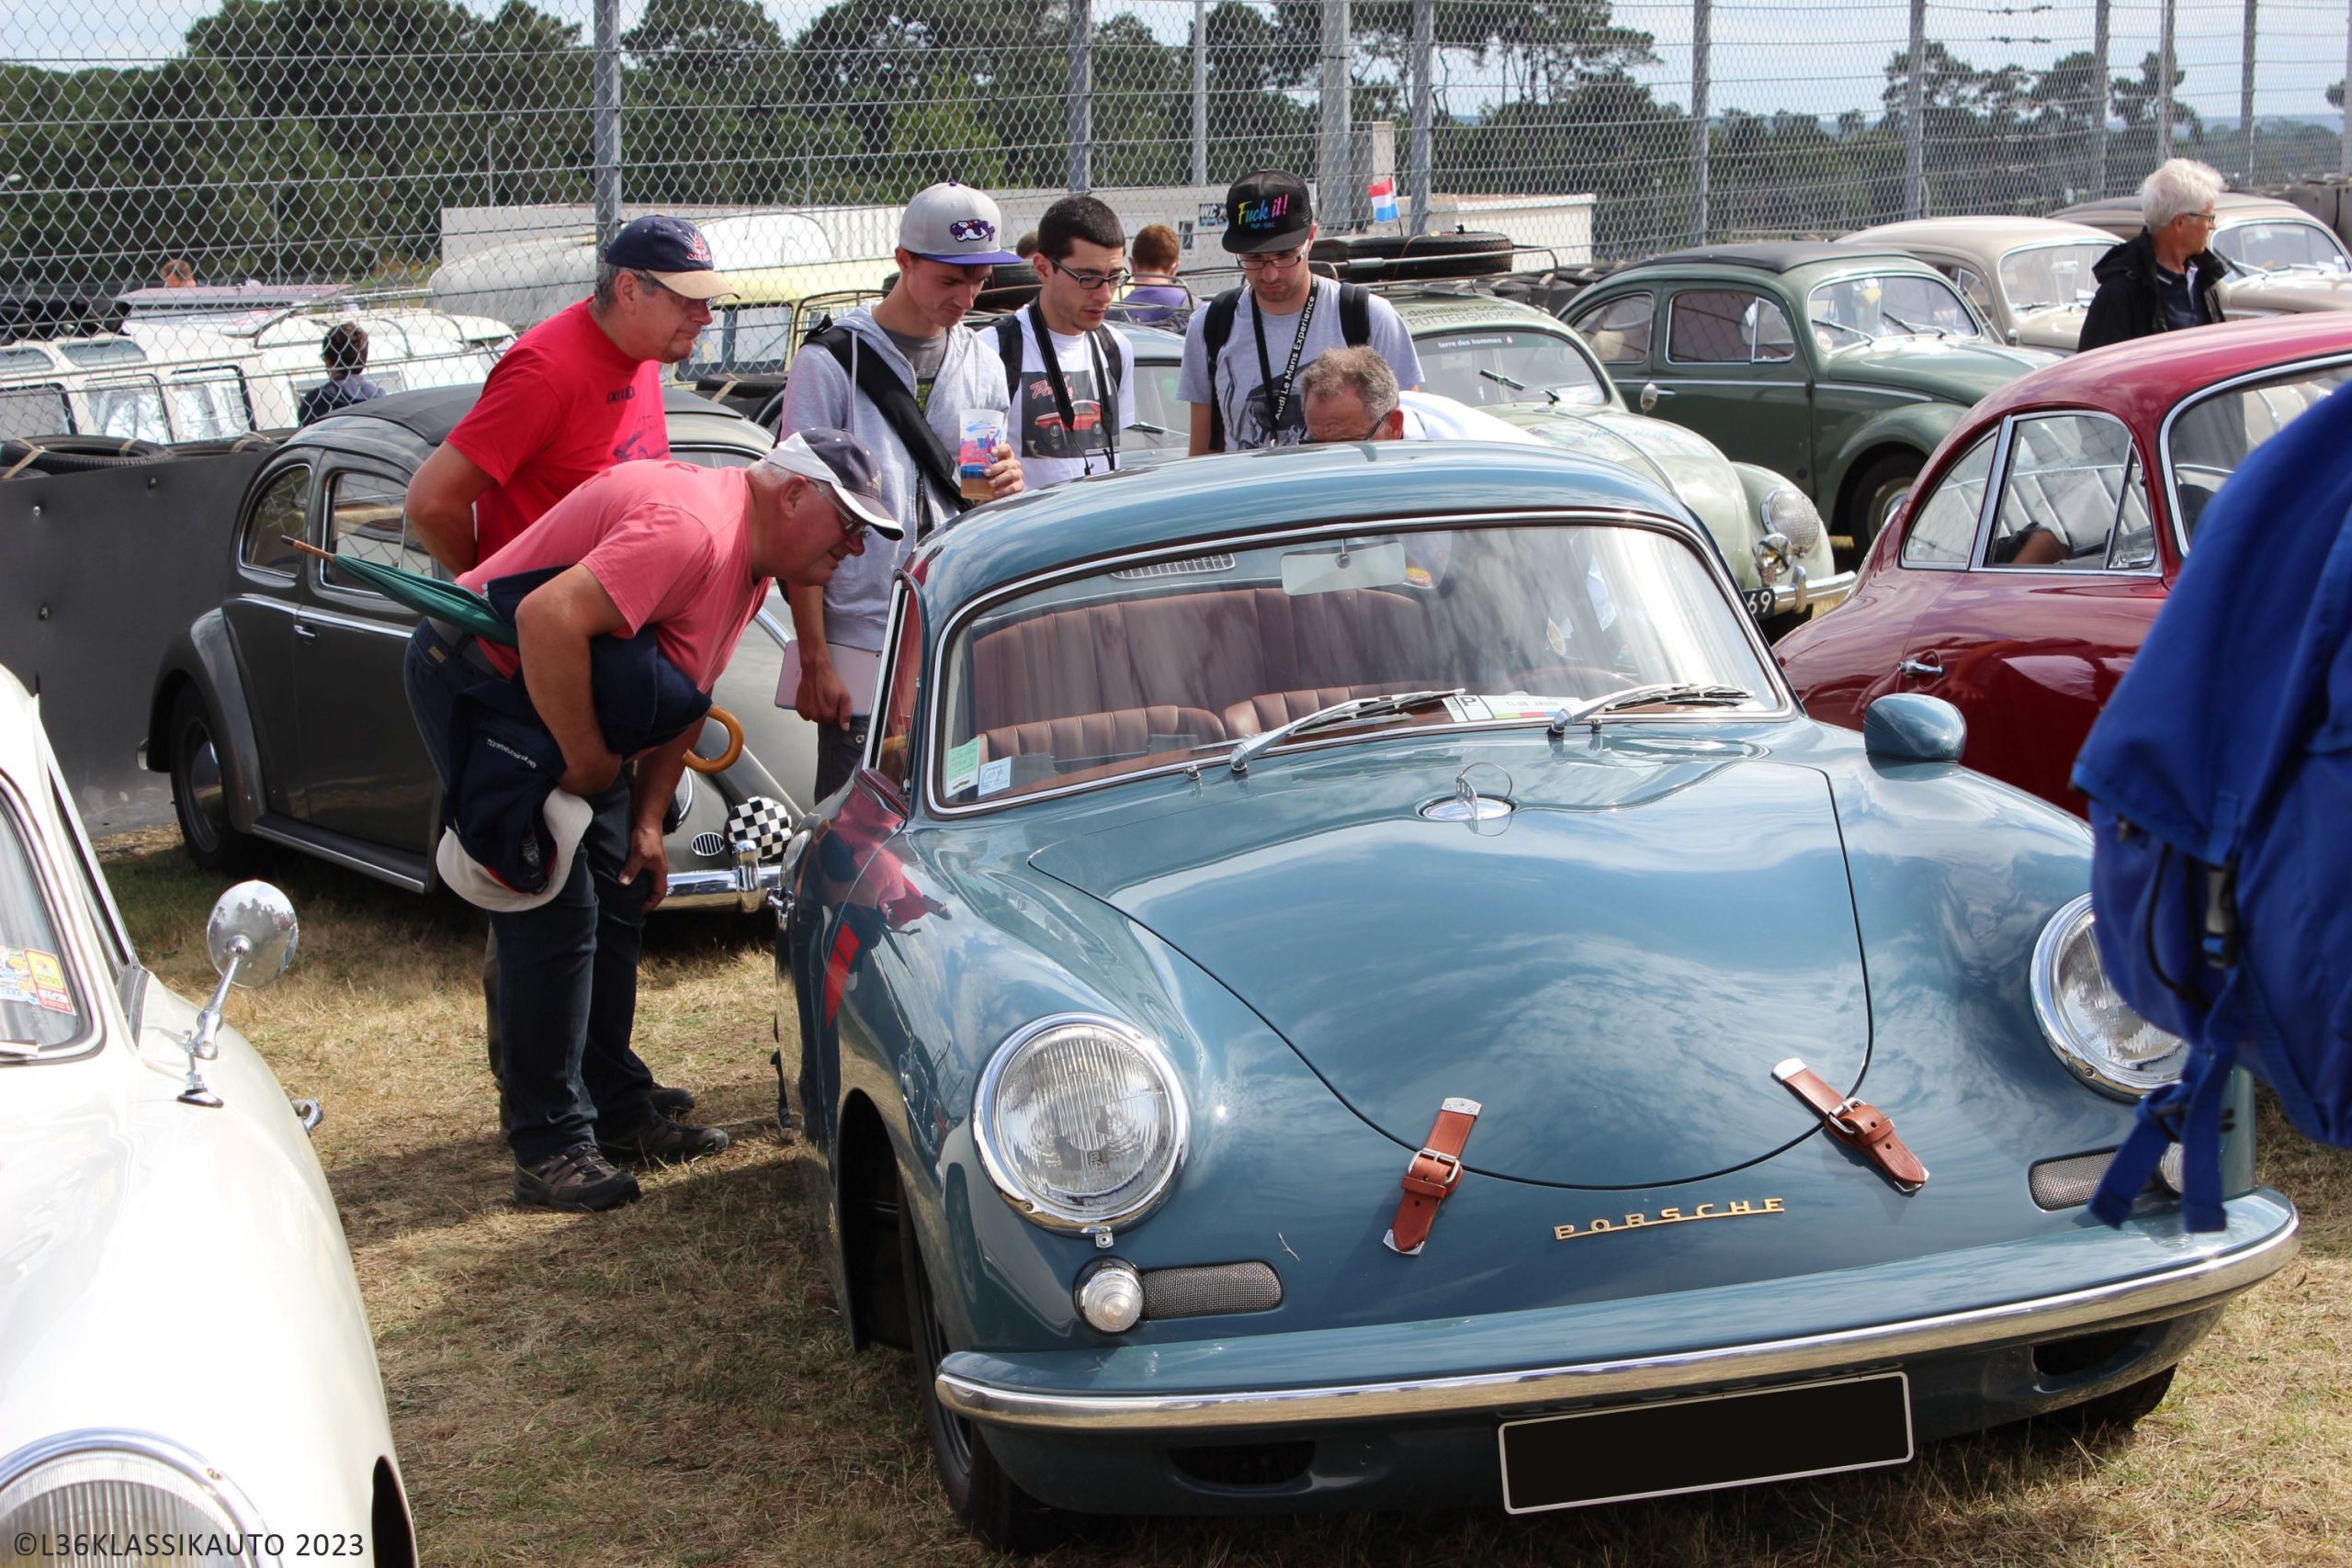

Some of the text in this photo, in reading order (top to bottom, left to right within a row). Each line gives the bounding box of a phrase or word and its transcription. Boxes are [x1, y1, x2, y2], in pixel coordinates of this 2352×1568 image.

[1238, 193, 1288, 225] Fuck it!
[1457, 339, 1470, 347] des
[1471, 336, 1502, 346] hommes
[1274, 295, 1316, 421] Audi Le Mans Experience
[1747, 591, 1771, 615] 69
[1459, 695, 1476, 706] P
[1554, 1198, 1785, 1240] PORSCHE
